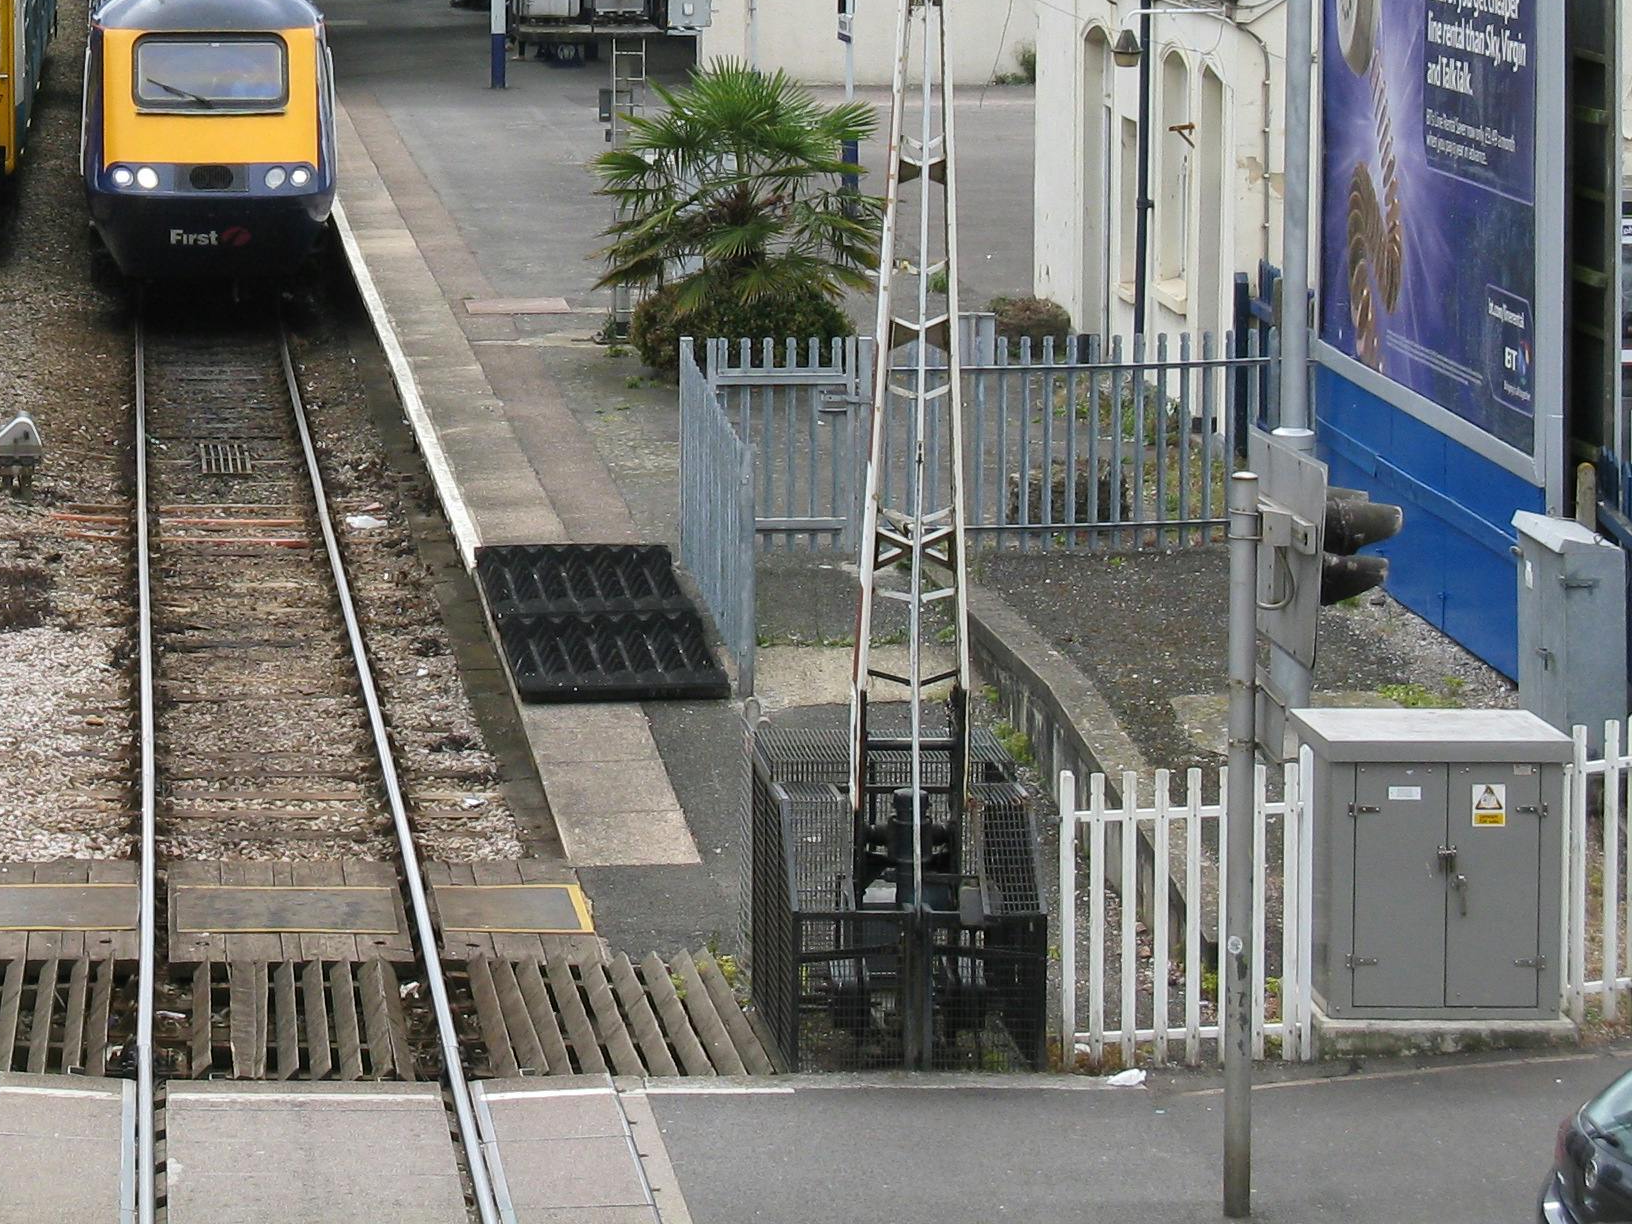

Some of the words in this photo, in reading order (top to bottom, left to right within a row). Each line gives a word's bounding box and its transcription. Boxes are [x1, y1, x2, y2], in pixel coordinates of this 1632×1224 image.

[1428, 10, 1442, 44] line
[1442, 17, 1466, 50] rental
[1466, 19, 1485, 55] than
[1485, 24, 1501, 67] Sky,
[1501, 28, 1527, 73] Virgin
[1427, 55, 1442, 87] and
[1442, 56, 1474, 96] TalkTalk.
[170, 229, 219, 245] First
[1504, 346, 1518, 371] BT
